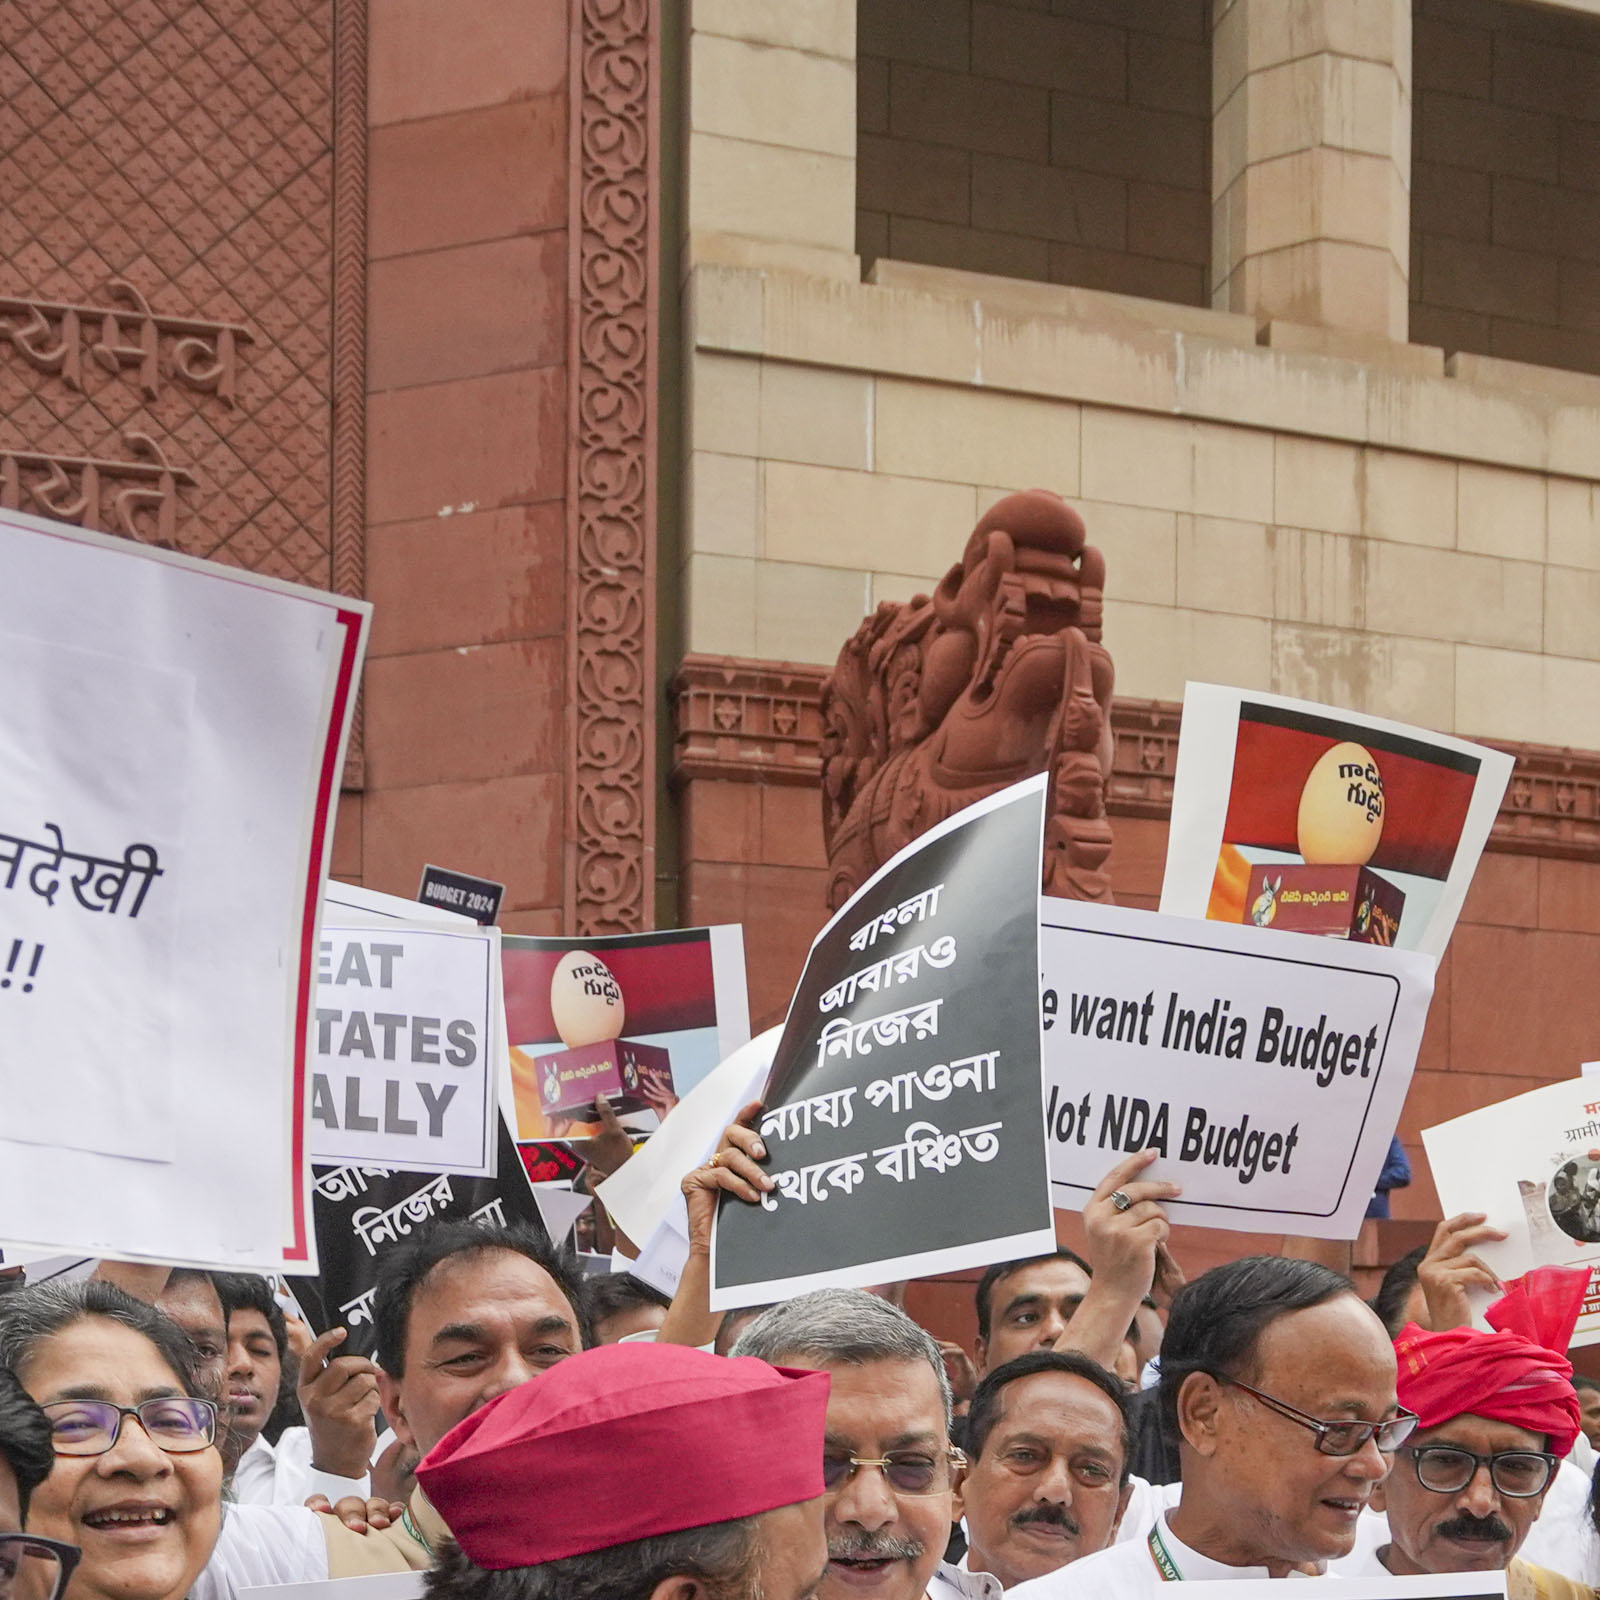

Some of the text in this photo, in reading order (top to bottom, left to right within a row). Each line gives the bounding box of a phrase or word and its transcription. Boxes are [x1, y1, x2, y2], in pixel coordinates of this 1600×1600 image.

[425, 881, 495, 913] BUDGET 2024
[848, 884, 944, 951] বাংলা
[819, 935, 957, 1013] আবারও
[316, 1008, 477, 1067] TATES
[817, 998, 944, 1068] নিজের
[1042, 974, 1378, 1088] e want India Budget
[313, 1073, 459, 1137] ALLY
[864, 1051, 1000, 1113] পাওনা
[1098, 1094, 1169, 1158] NDA
[1179, 1106, 1299, 1184] Budget
[352, 1173, 454, 1257] নিজের
